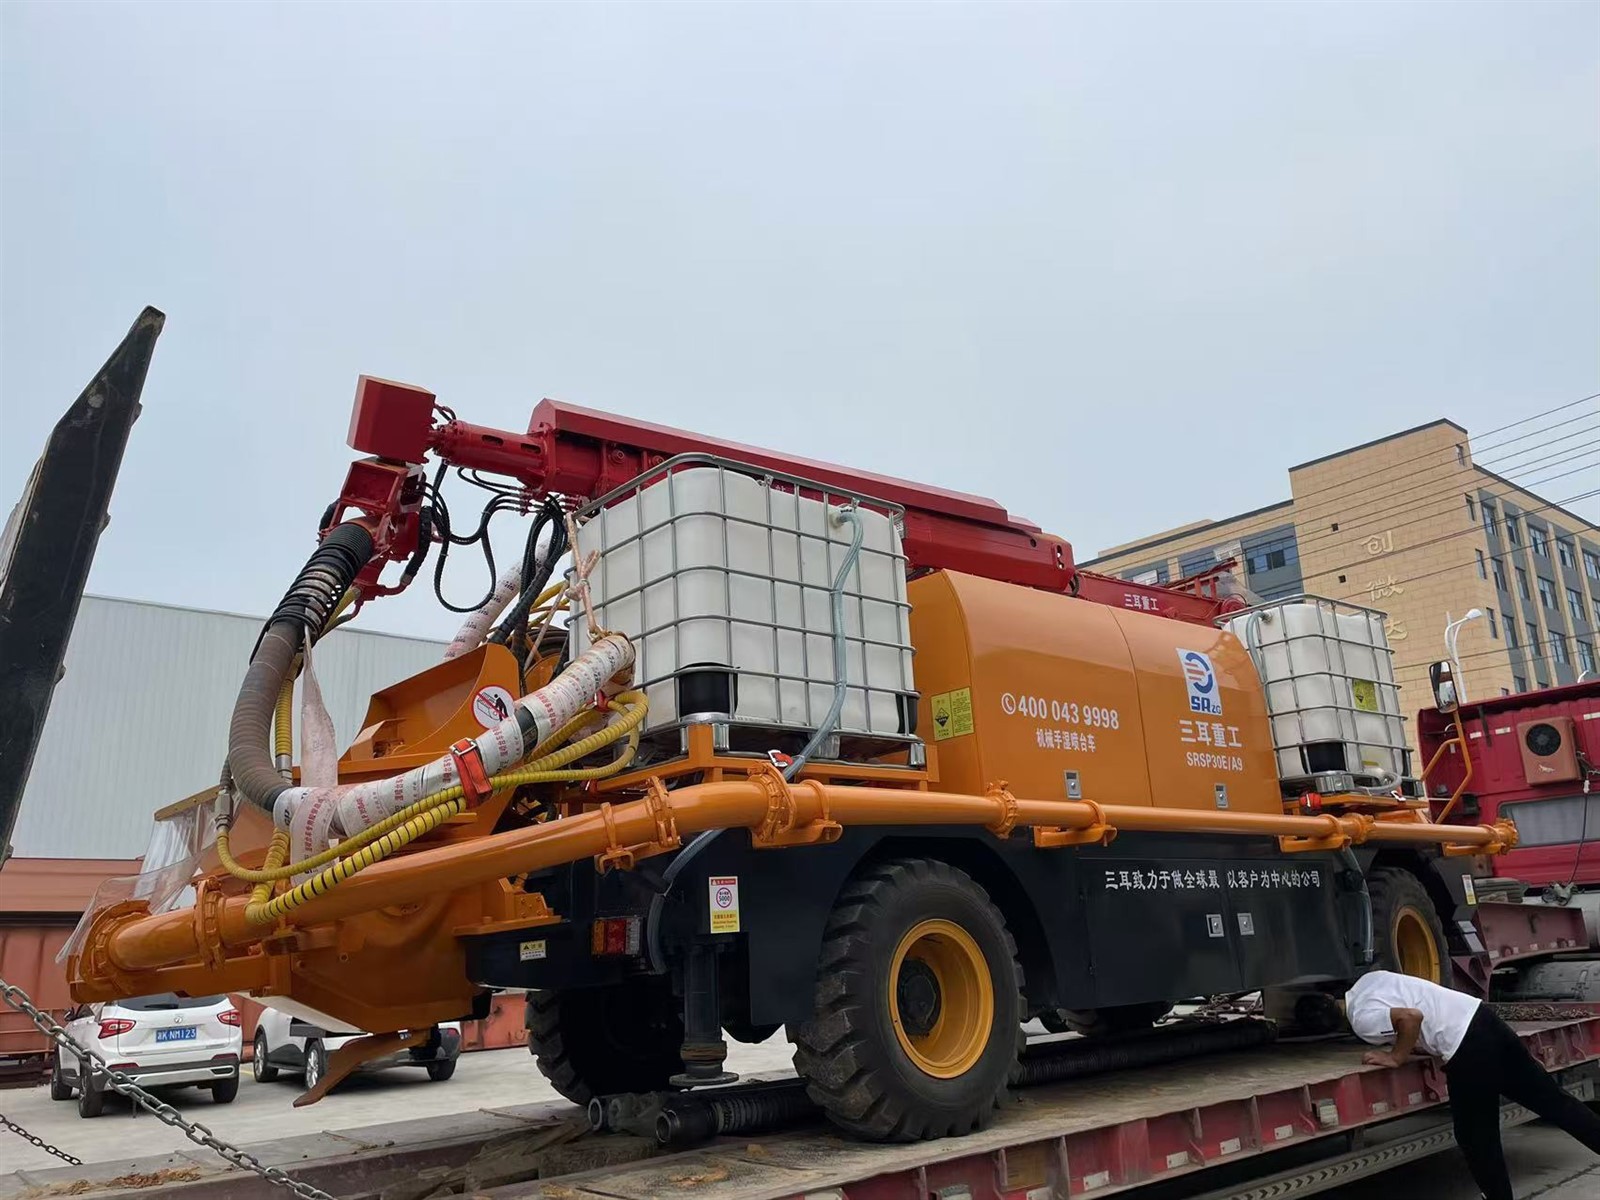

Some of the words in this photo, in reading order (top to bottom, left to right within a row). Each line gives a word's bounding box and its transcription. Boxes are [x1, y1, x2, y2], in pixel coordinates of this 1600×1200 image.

[1124, 594, 1159, 610] 三耳重工
[1017, 696, 1047, 719] 400
[1052, 701, 1079, 724] 043
[1082, 706, 1119, 729] 9998
[1191, 696, 1211, 713] SR
[1036, 728, 1096, 752] 机械手湿喷台车
[1179, 719, 1242, 747] 三耳重工
[1104, 869, 1220, 890] 三耳致力于做全球最
[1226, 869, 1321, 889] 以客户为中心的公司
